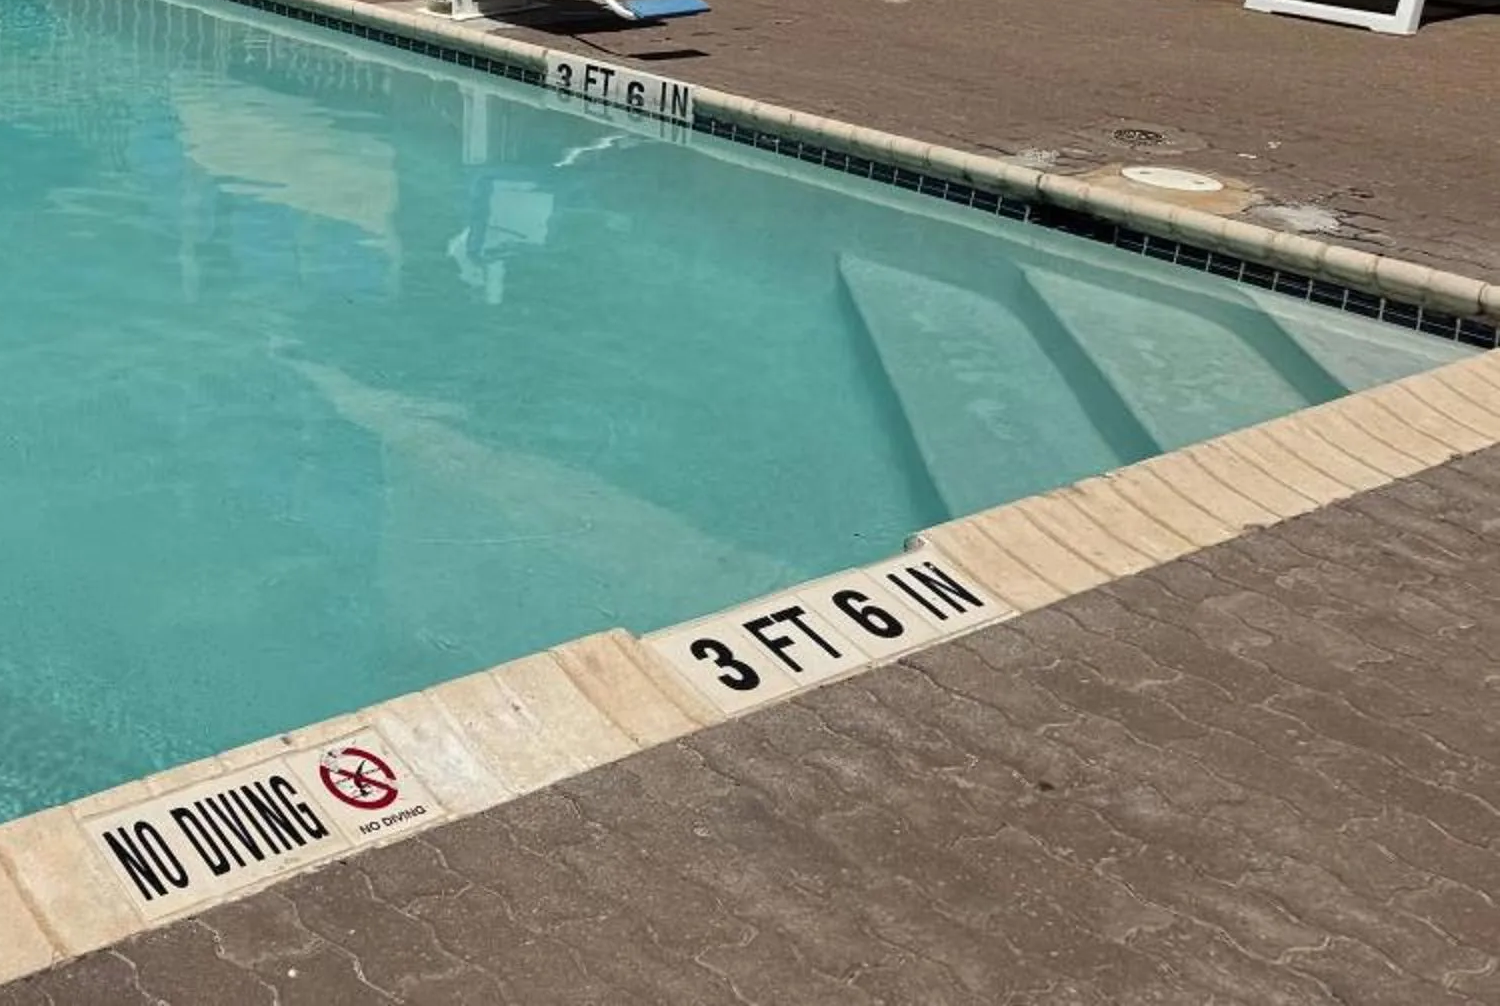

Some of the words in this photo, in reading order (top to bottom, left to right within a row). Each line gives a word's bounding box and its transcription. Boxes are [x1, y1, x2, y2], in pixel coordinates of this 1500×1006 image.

[556, 63, 573, 87] 3
[584, 64, 615, 97] FT
[627, 81, 645, 107] 6
[660, 81, 689, 119] IN
[689, 637, 760, 691] 3
[742, 605, 843, 673] FT
[831, 590, 905, 639] 6
[886, 561, 985, 621] IN
[103, 820, 189, 901] NO
[169, 774, 329, 877] DIVING
[359, 819, 380, 836] NO
[381, 804, 427, 829] DIVING
